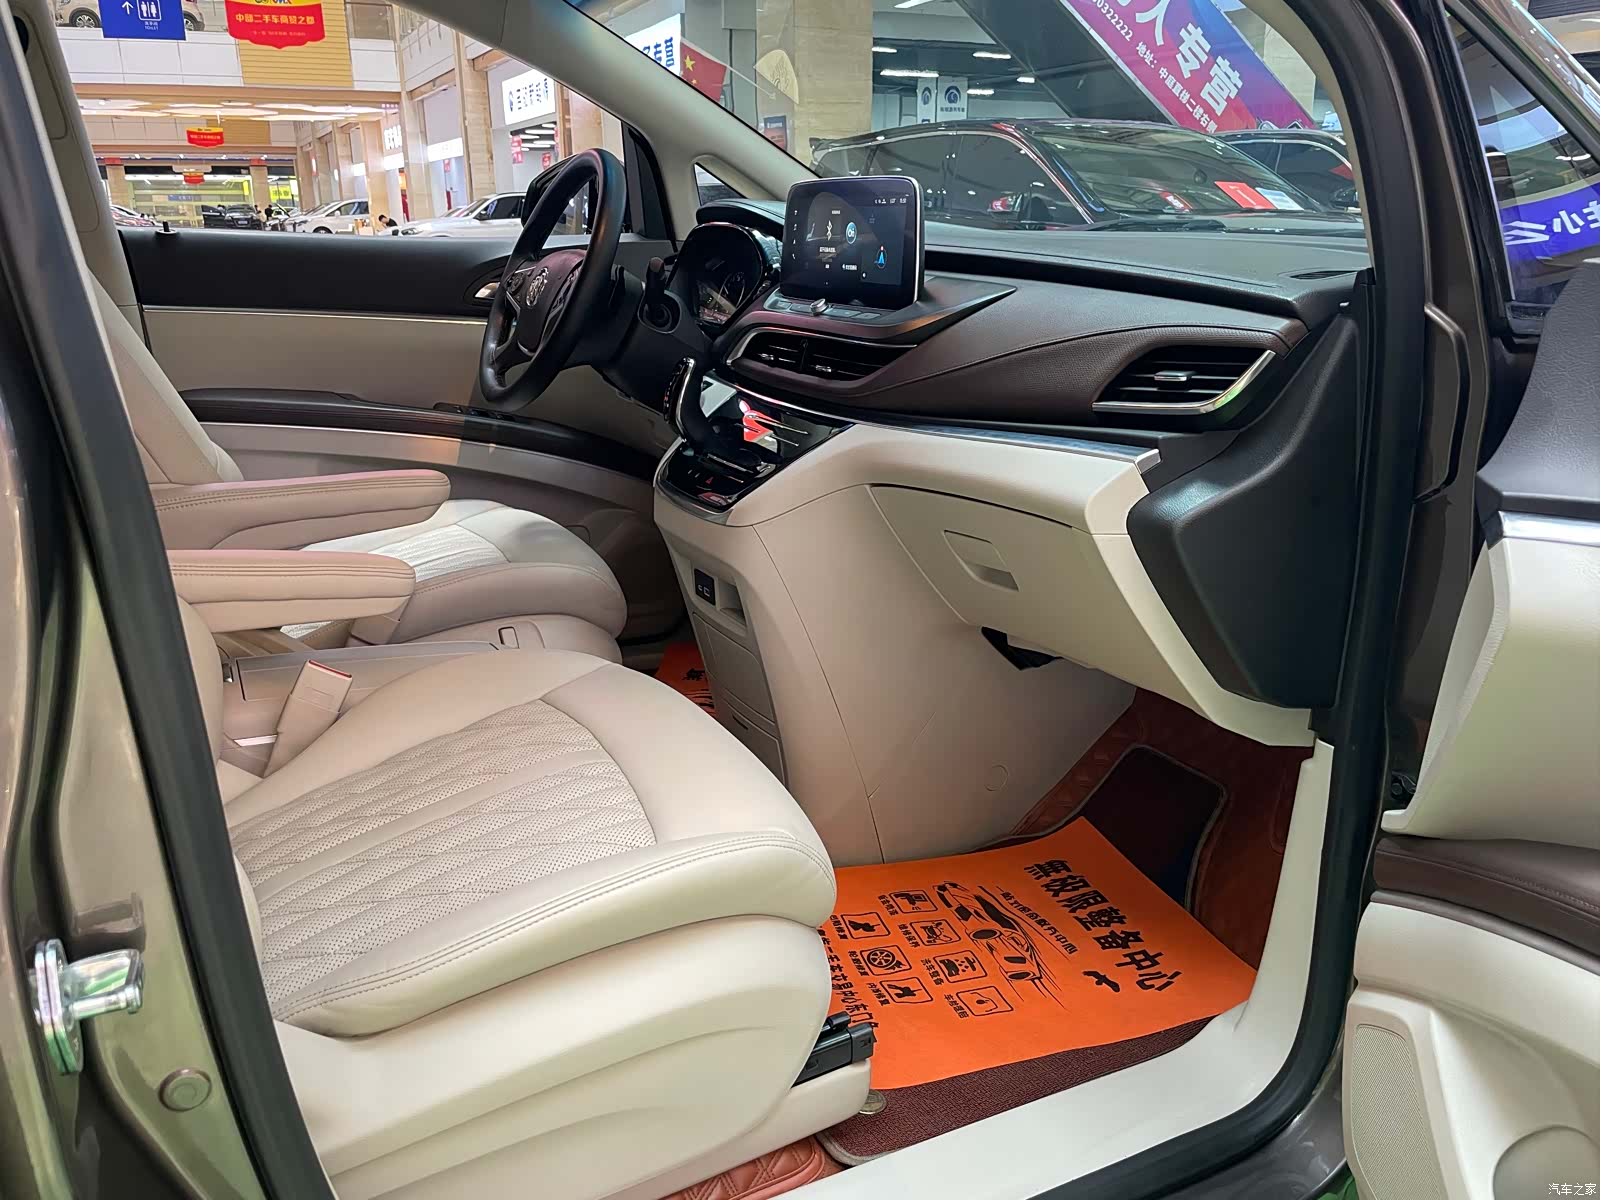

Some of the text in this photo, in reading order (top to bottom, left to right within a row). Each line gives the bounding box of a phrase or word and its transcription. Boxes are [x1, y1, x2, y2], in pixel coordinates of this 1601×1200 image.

[1092, 0, 1133, 41] 0322222
[1116, 0, 1243, 117] 人专营
[1024, 859, 1182, 992] 無极限整备中心
